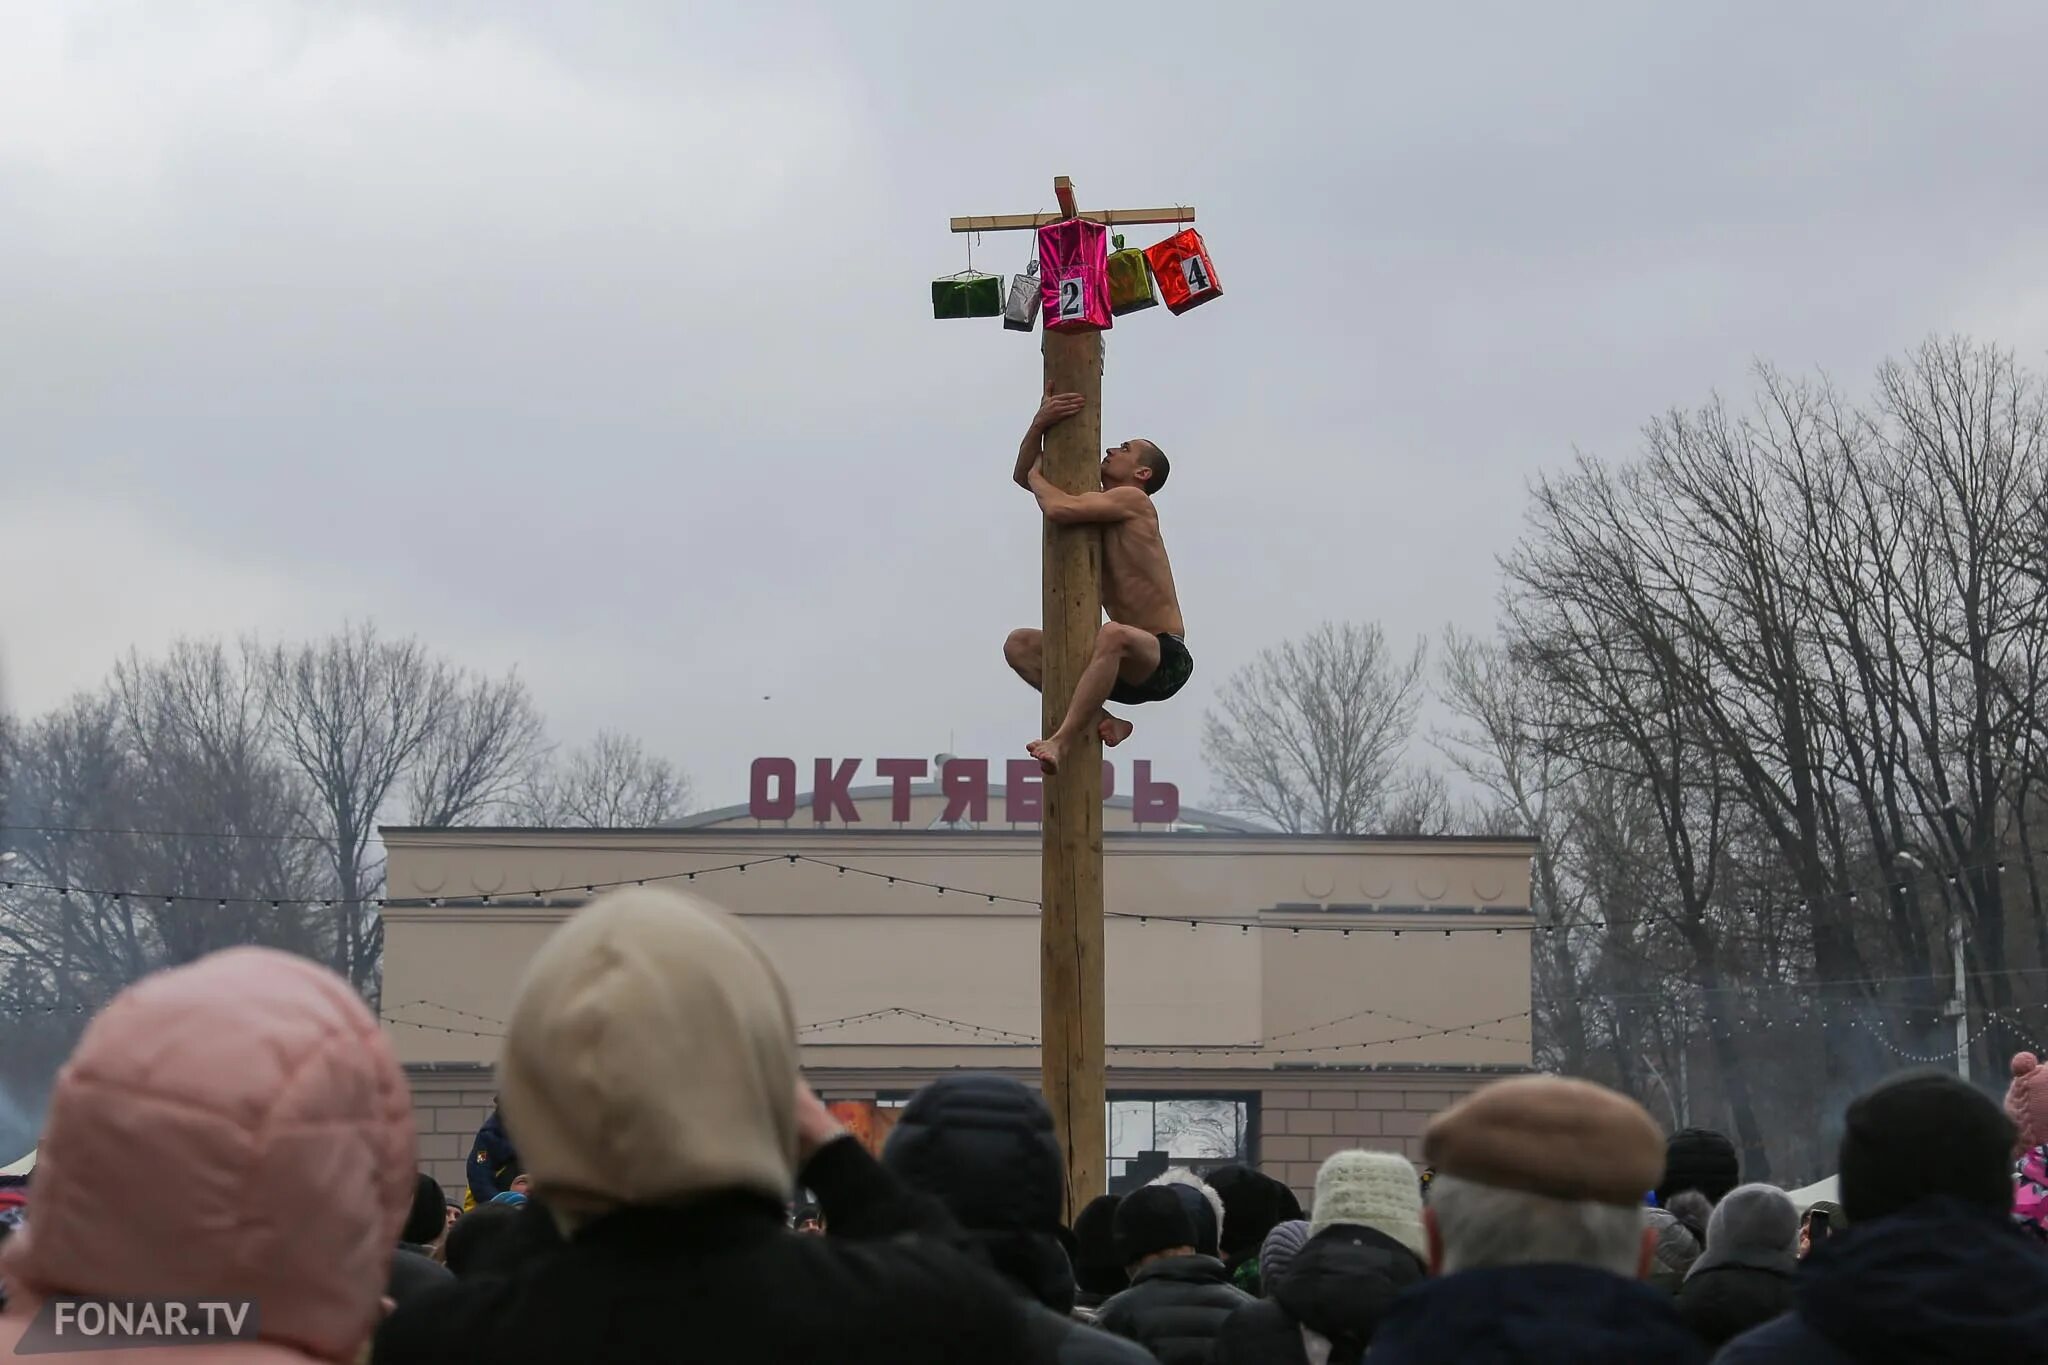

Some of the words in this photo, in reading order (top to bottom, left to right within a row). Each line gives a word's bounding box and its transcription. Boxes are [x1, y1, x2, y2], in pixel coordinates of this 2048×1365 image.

[1189, 257, 1208, 290] 4
[1062, 282, 1079, 315] 2
[749, 757, 1179, 823] ОКТЯБЬ
